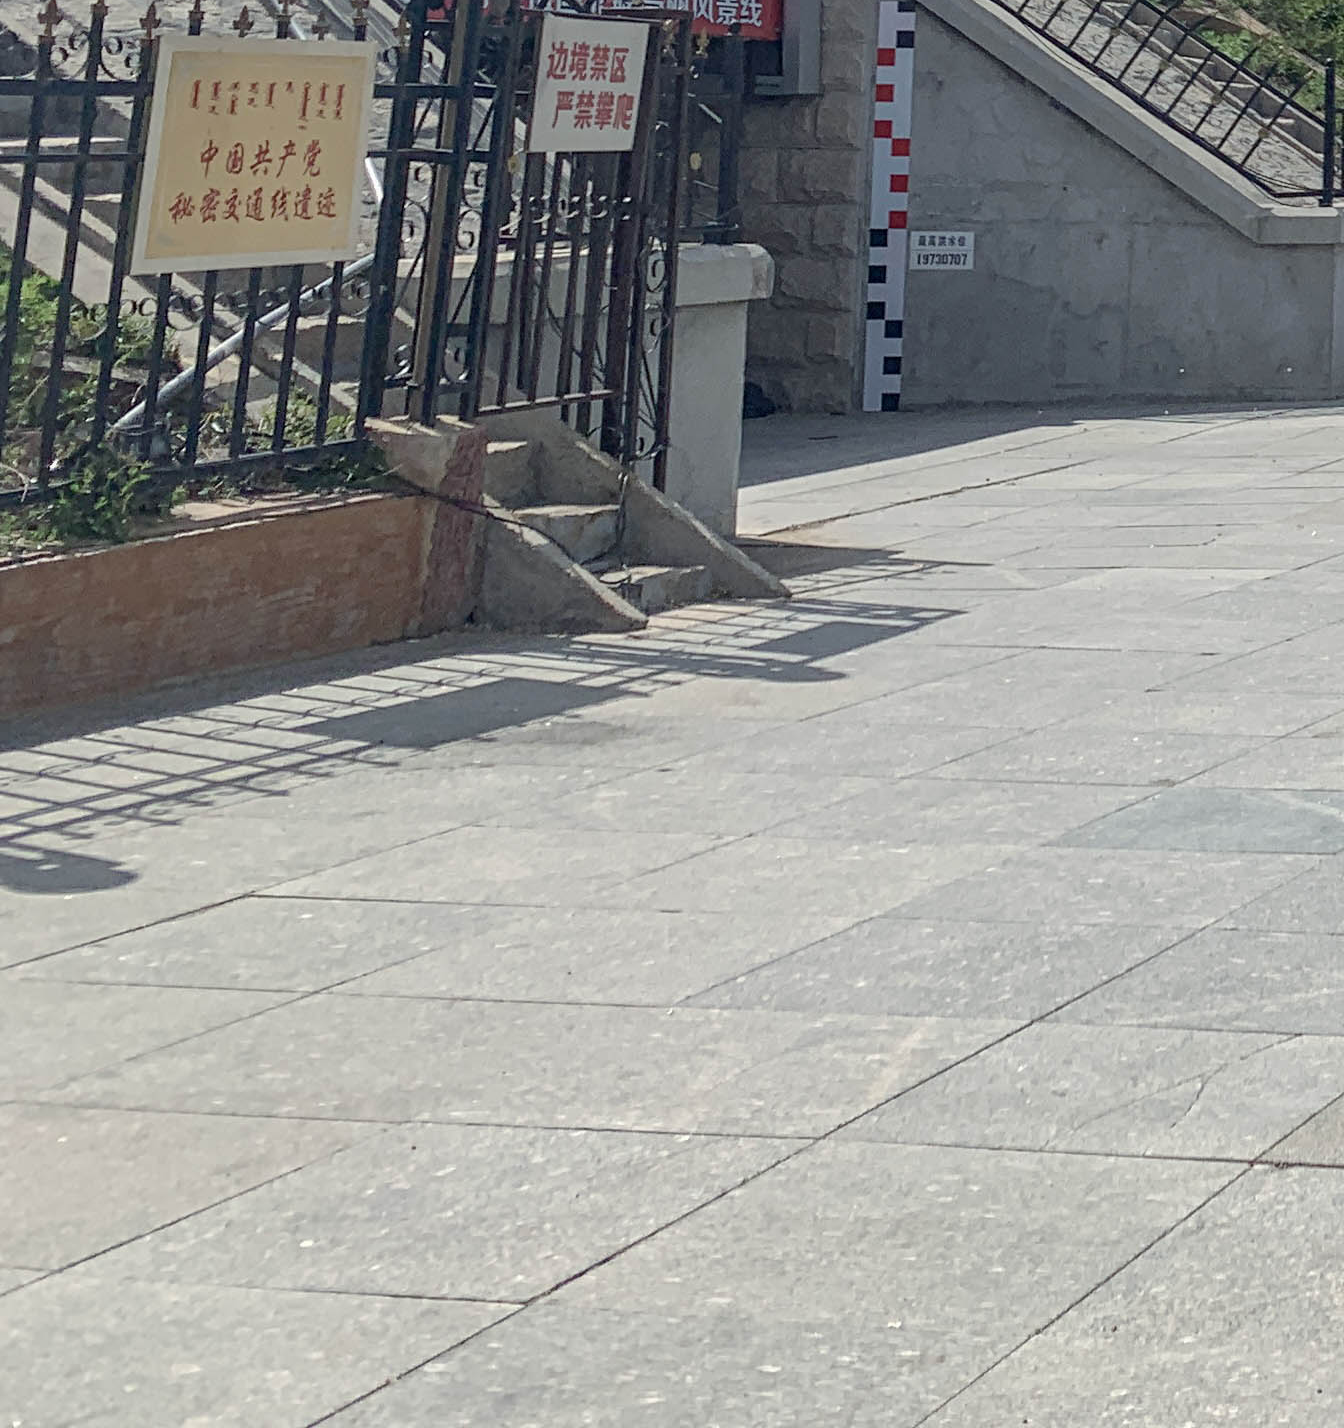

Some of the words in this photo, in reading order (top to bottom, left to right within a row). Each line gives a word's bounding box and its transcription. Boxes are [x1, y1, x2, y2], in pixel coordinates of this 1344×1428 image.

[547, 41, 630, 84] 边境禁区
[552, 90, 635, 130] 严禁攀爬
[200, 139, 322, 178] 中国共产党
[168, 184, 337, 224] 秘密交通线遗迹
[917, 253, 968, 266] 19730707
